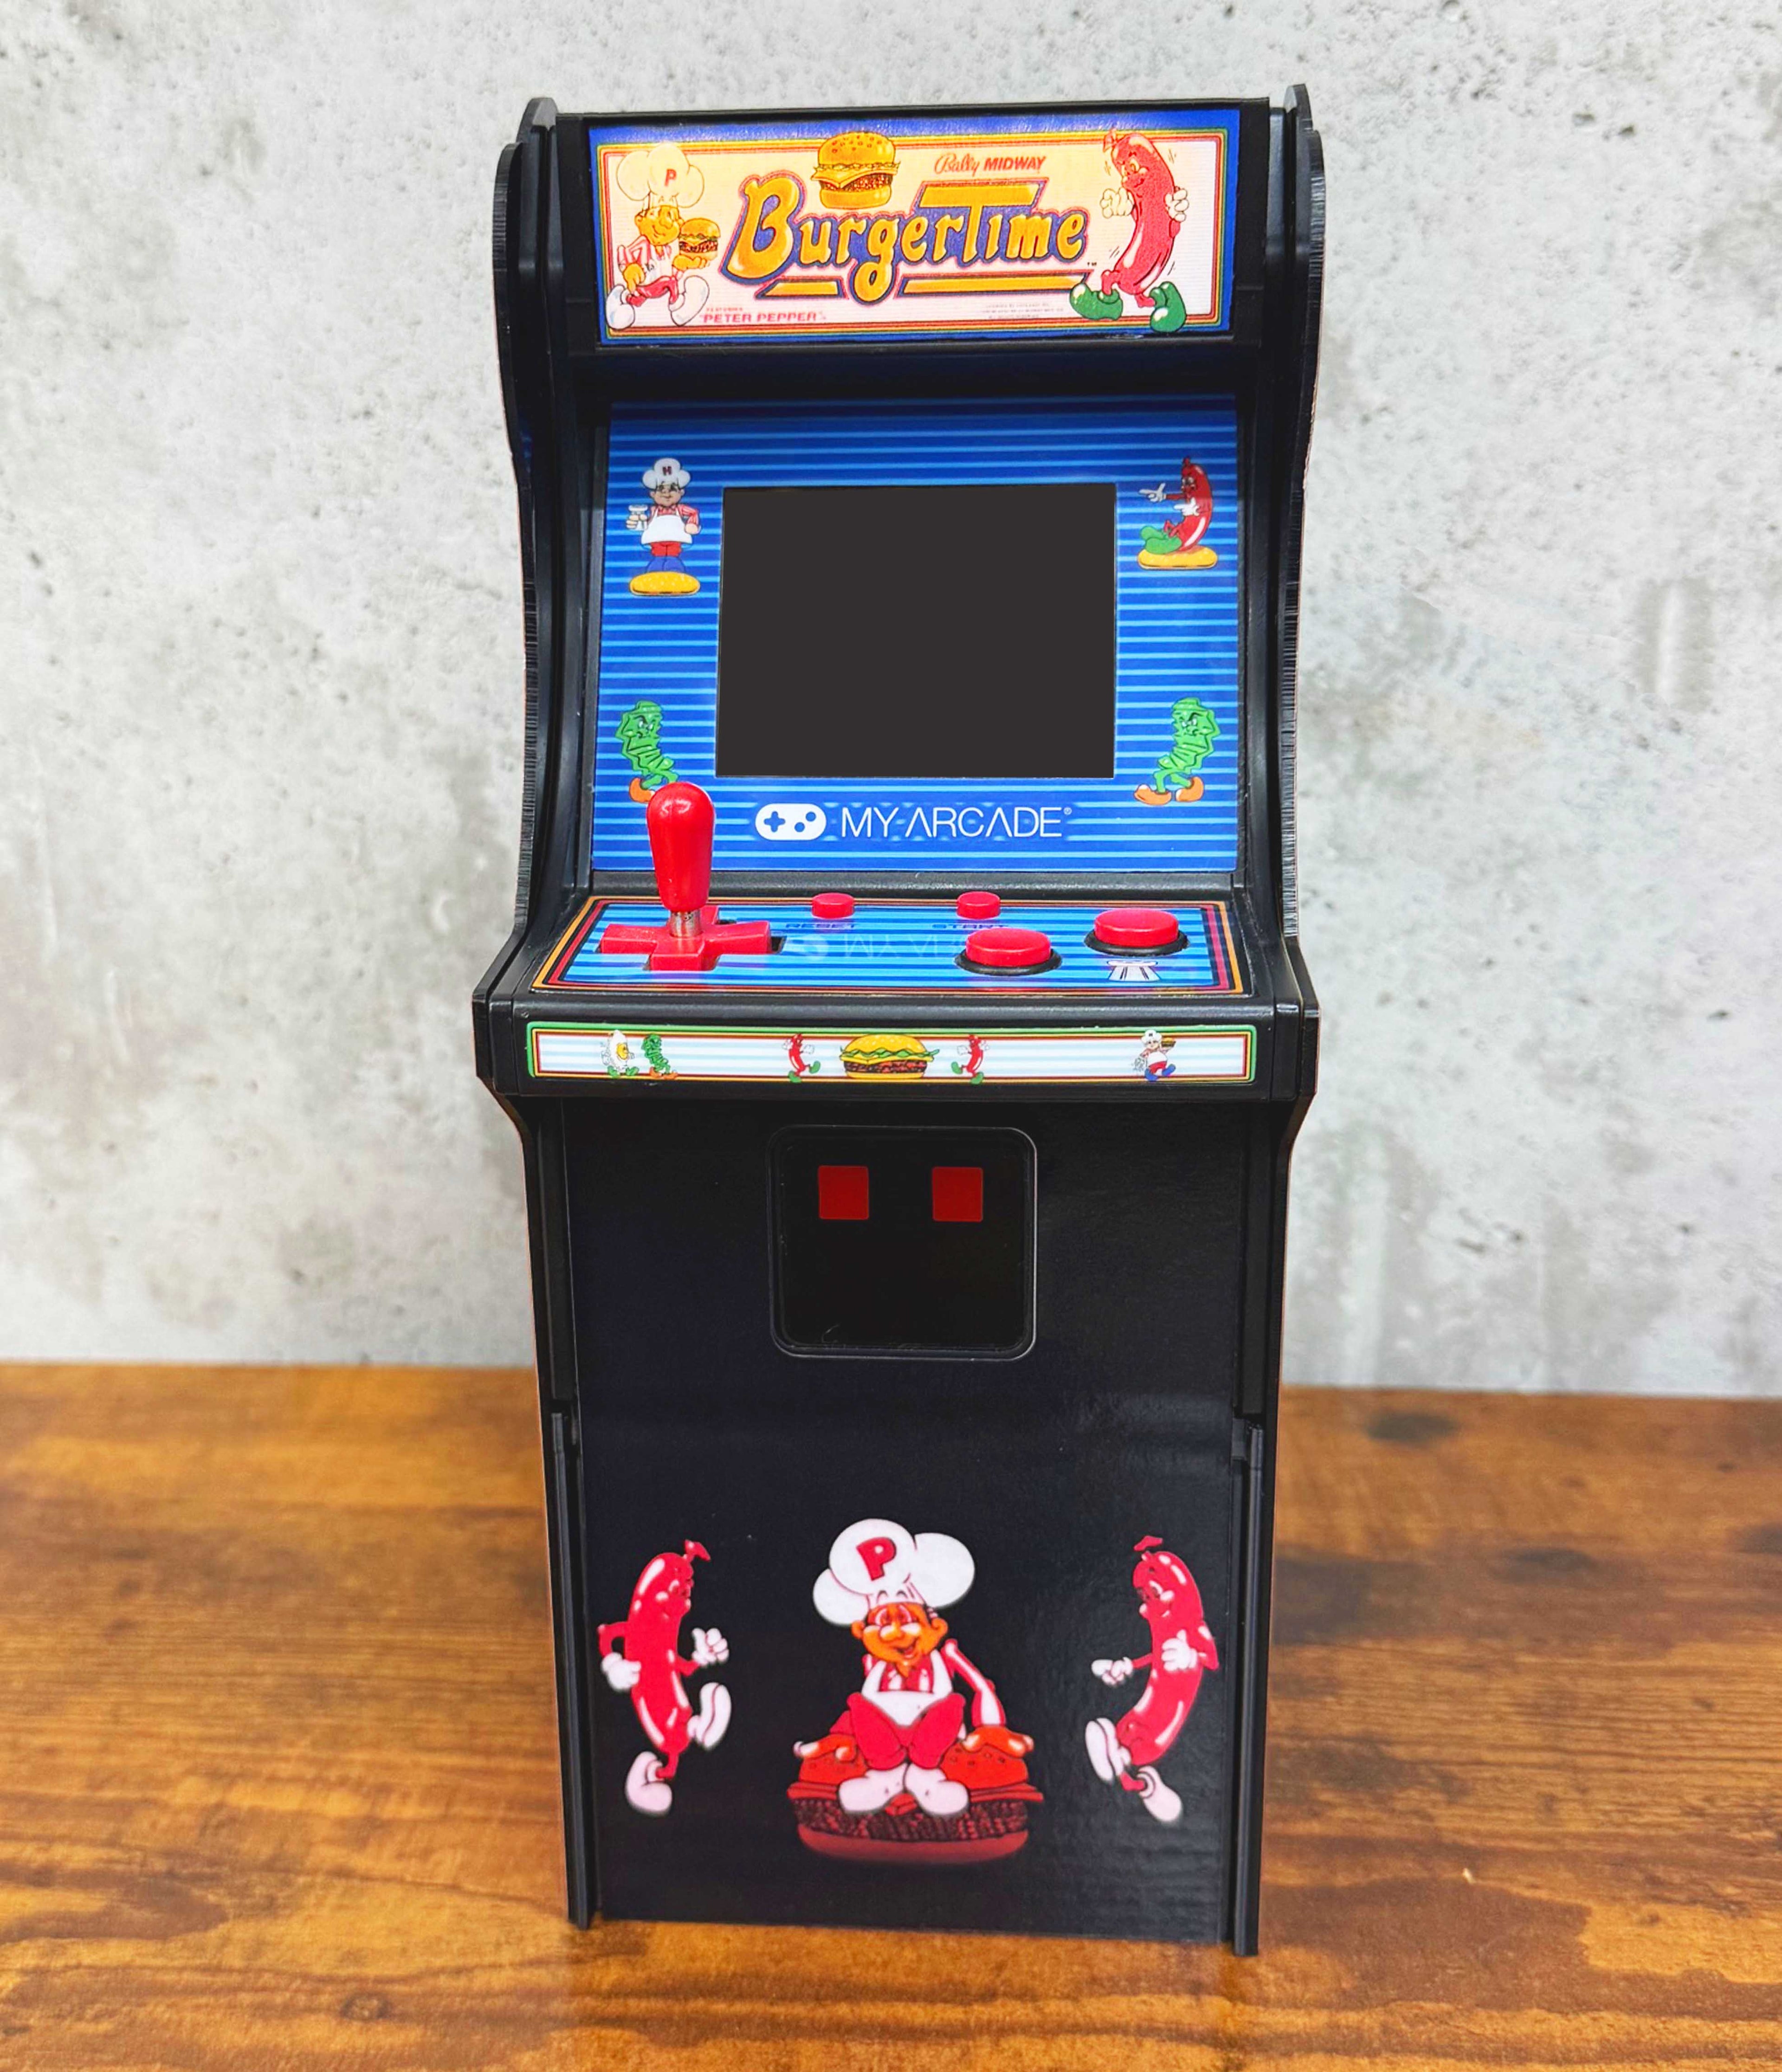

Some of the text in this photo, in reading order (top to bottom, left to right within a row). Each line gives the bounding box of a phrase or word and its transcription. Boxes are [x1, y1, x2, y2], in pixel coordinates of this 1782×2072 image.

[664, 168, 677, 187] P
[934, 152, 1046, 177] Bally MIDWAY
[842, 807, 898, 838] MY
[856, 1536, 897, 1581] P
